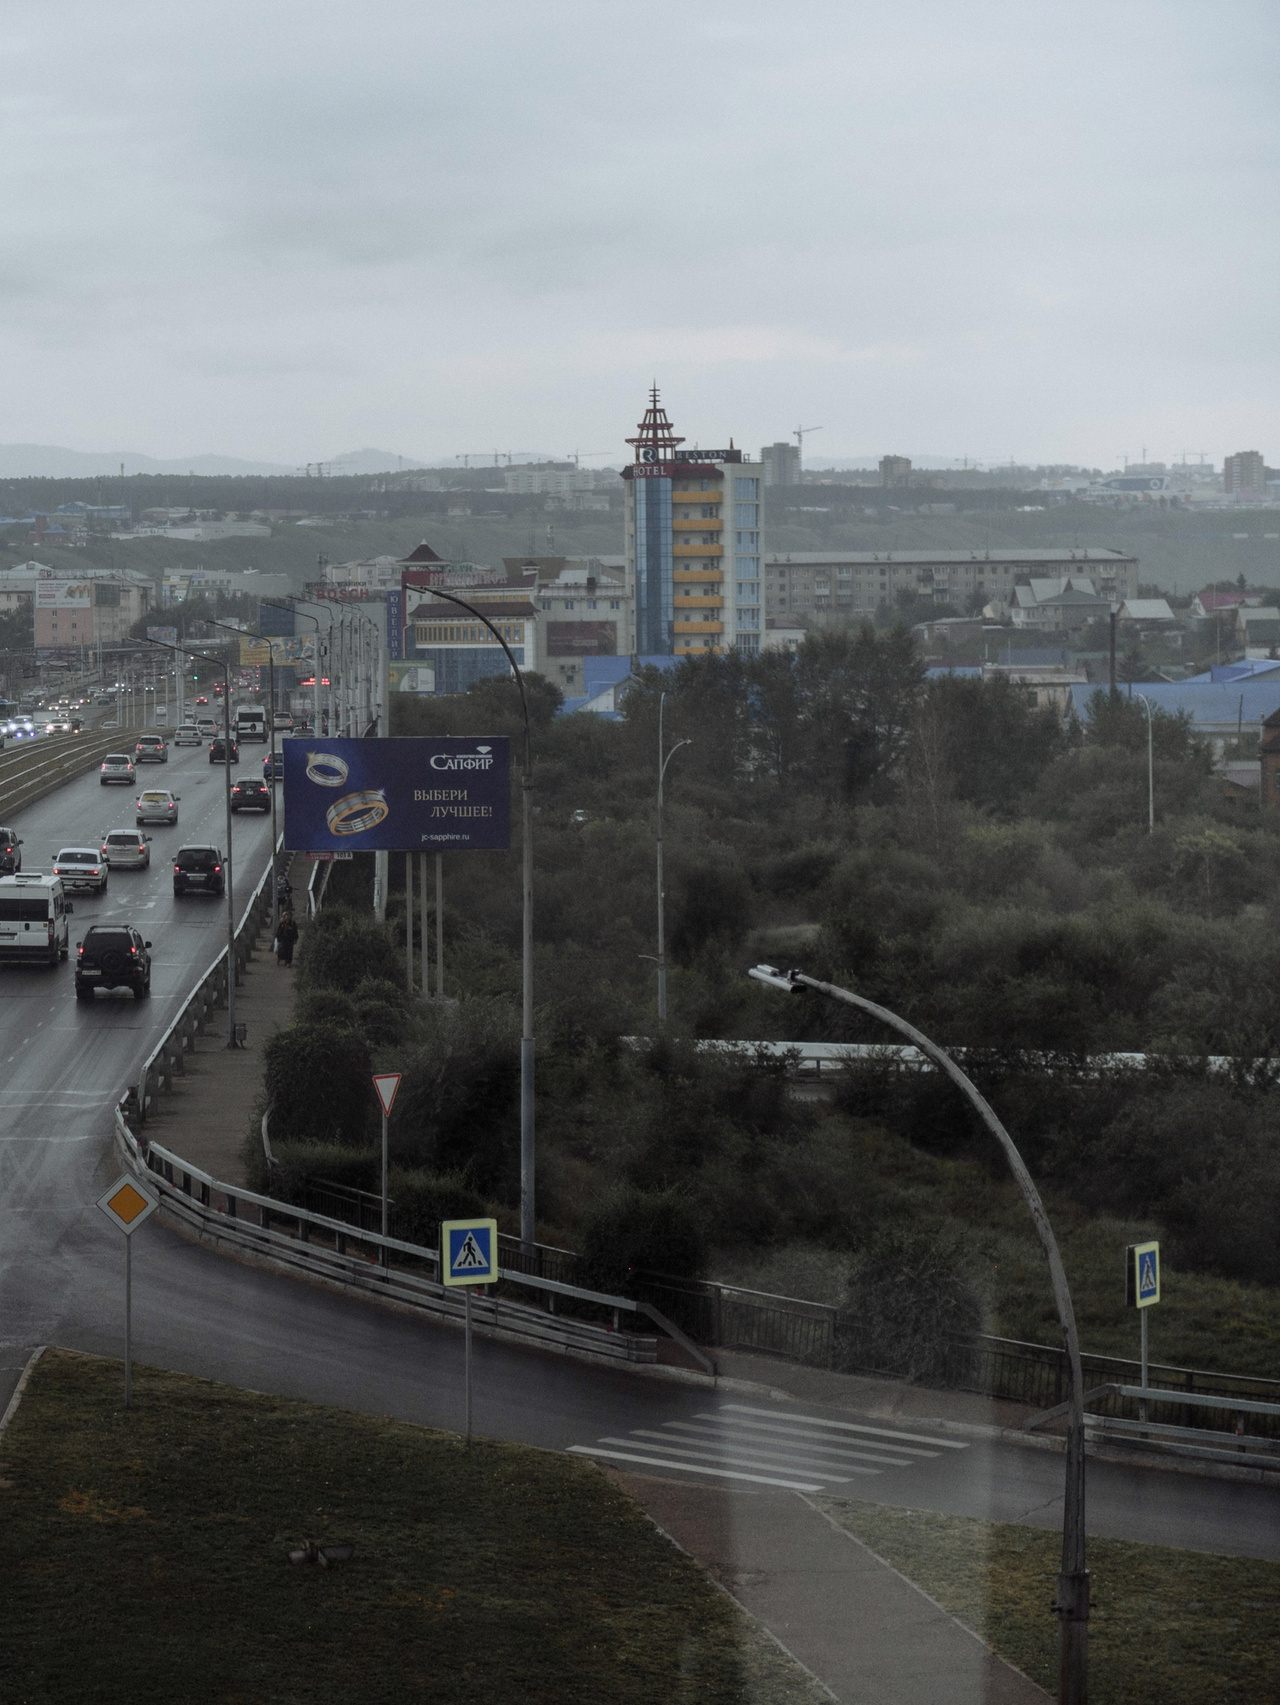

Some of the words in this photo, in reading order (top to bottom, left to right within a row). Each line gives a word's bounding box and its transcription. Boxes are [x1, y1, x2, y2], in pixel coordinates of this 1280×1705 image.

[317, 588, 369, 600] BOSCH
[430, 753, 494, 770] САПФИР
[413, 789, 468, 802] ВЫБЕРИ
[430, 805, 493, 818] ЛУЧШЕЕ!
[421, 833, 470, 842] jc-sapphire.ru
